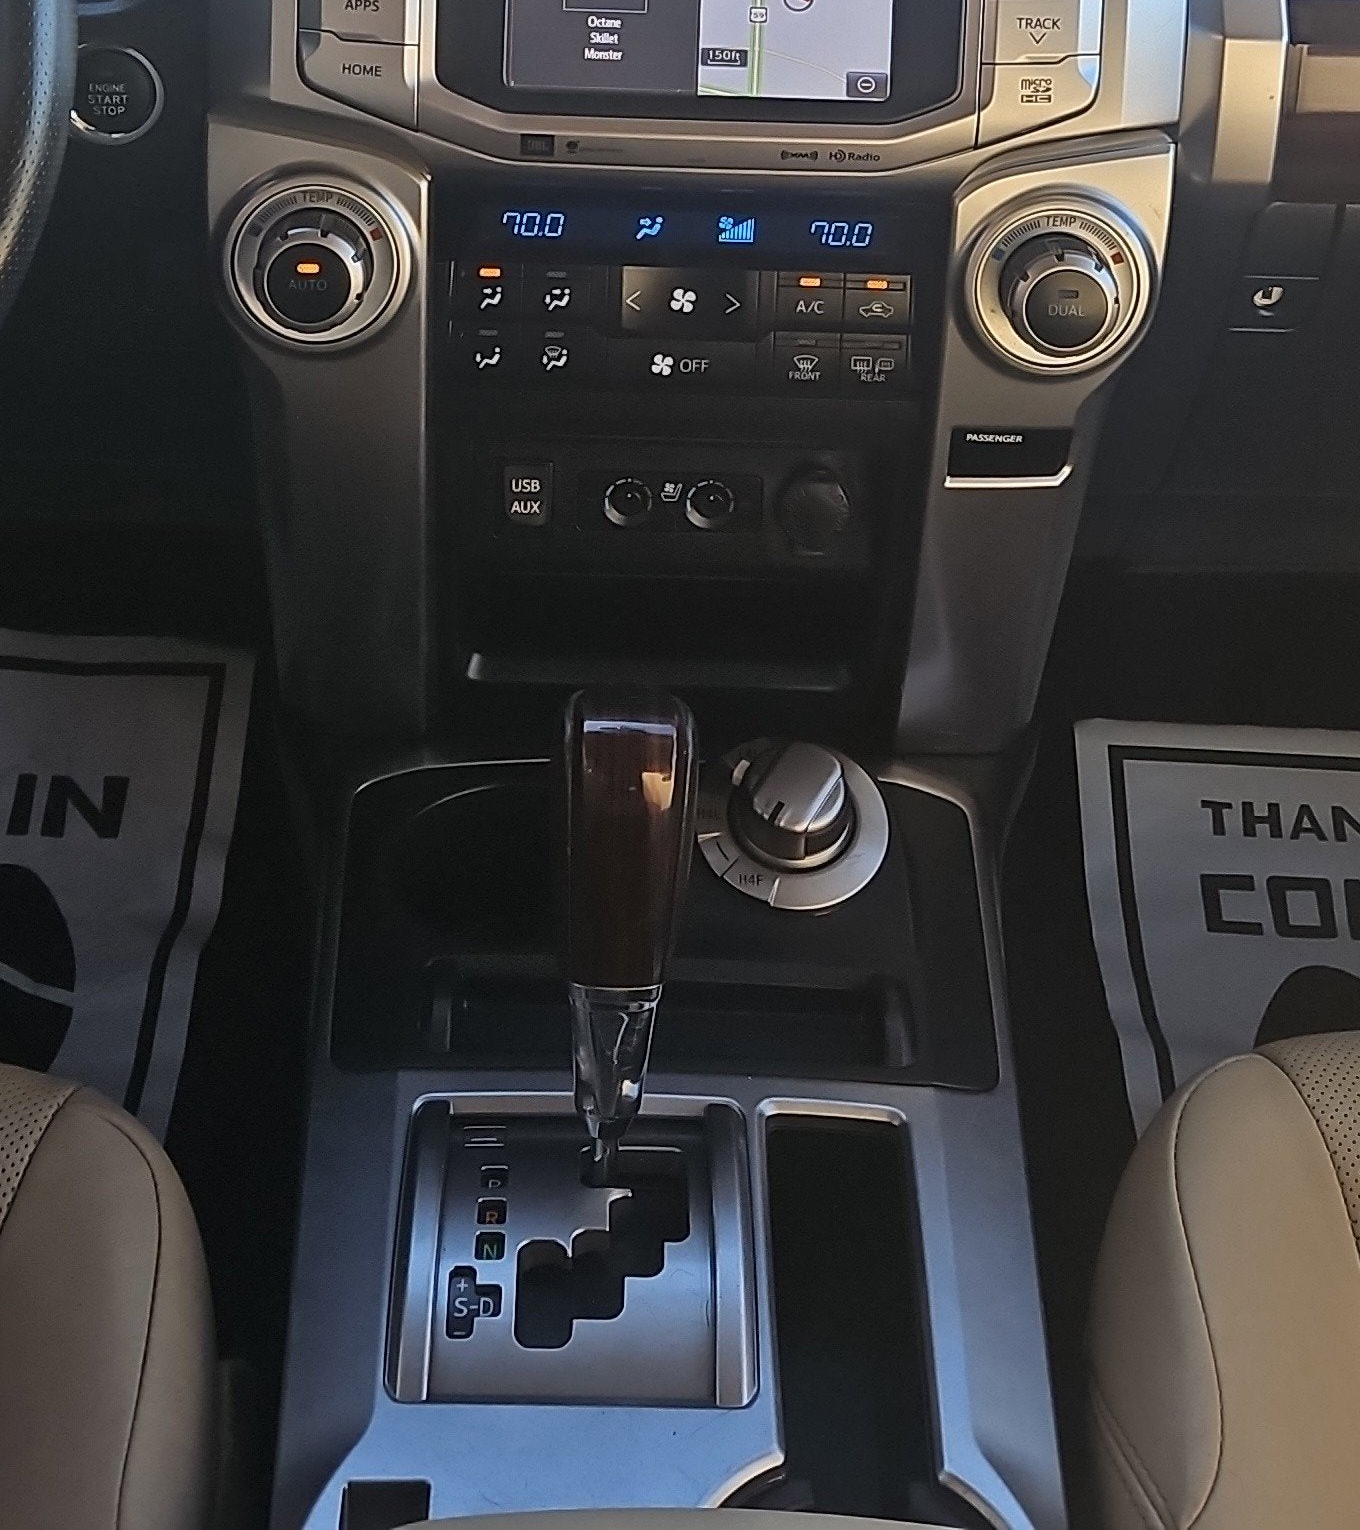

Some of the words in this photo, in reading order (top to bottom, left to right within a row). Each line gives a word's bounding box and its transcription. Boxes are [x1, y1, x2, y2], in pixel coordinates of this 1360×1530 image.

[587, 16, 622, 28] Octane
[1017, 17, 1061, 30] TRACK
[589, 32, 619, 44] Skillet
[584, 47, 623, 61] Monster
[341, 63, 382, 78] HOME
[89, 83, 126, 93] ENGINE
[88, 94, 129, 105] START
[93, 105, 126, 116] STOP
[847, 152, 881, 162] Radio
[300, 191, 334, 203] TEMP
[502, 211, 566, 238] 70.0
[1044, 215, 1077, 228] TEMP
[810, 220, 873, 247] 70.0
[289, 279, 328, 291] AUTO
[796, 299, 825, 314] A/C
[1047, 304, 1086, 317] DUAL
[679, 358, 710, 374] OFF
[789, 371, 821, 381] FRONT
[860, 373, 886, 382] REAR
[966, 433, 1024, 443] PASSENGER
[511, 478, 540, 493] USB
[510, 501, 541, 515] AUX
[5, 772, 131, 840] IN
[483, 1244, 498, 1259] N
